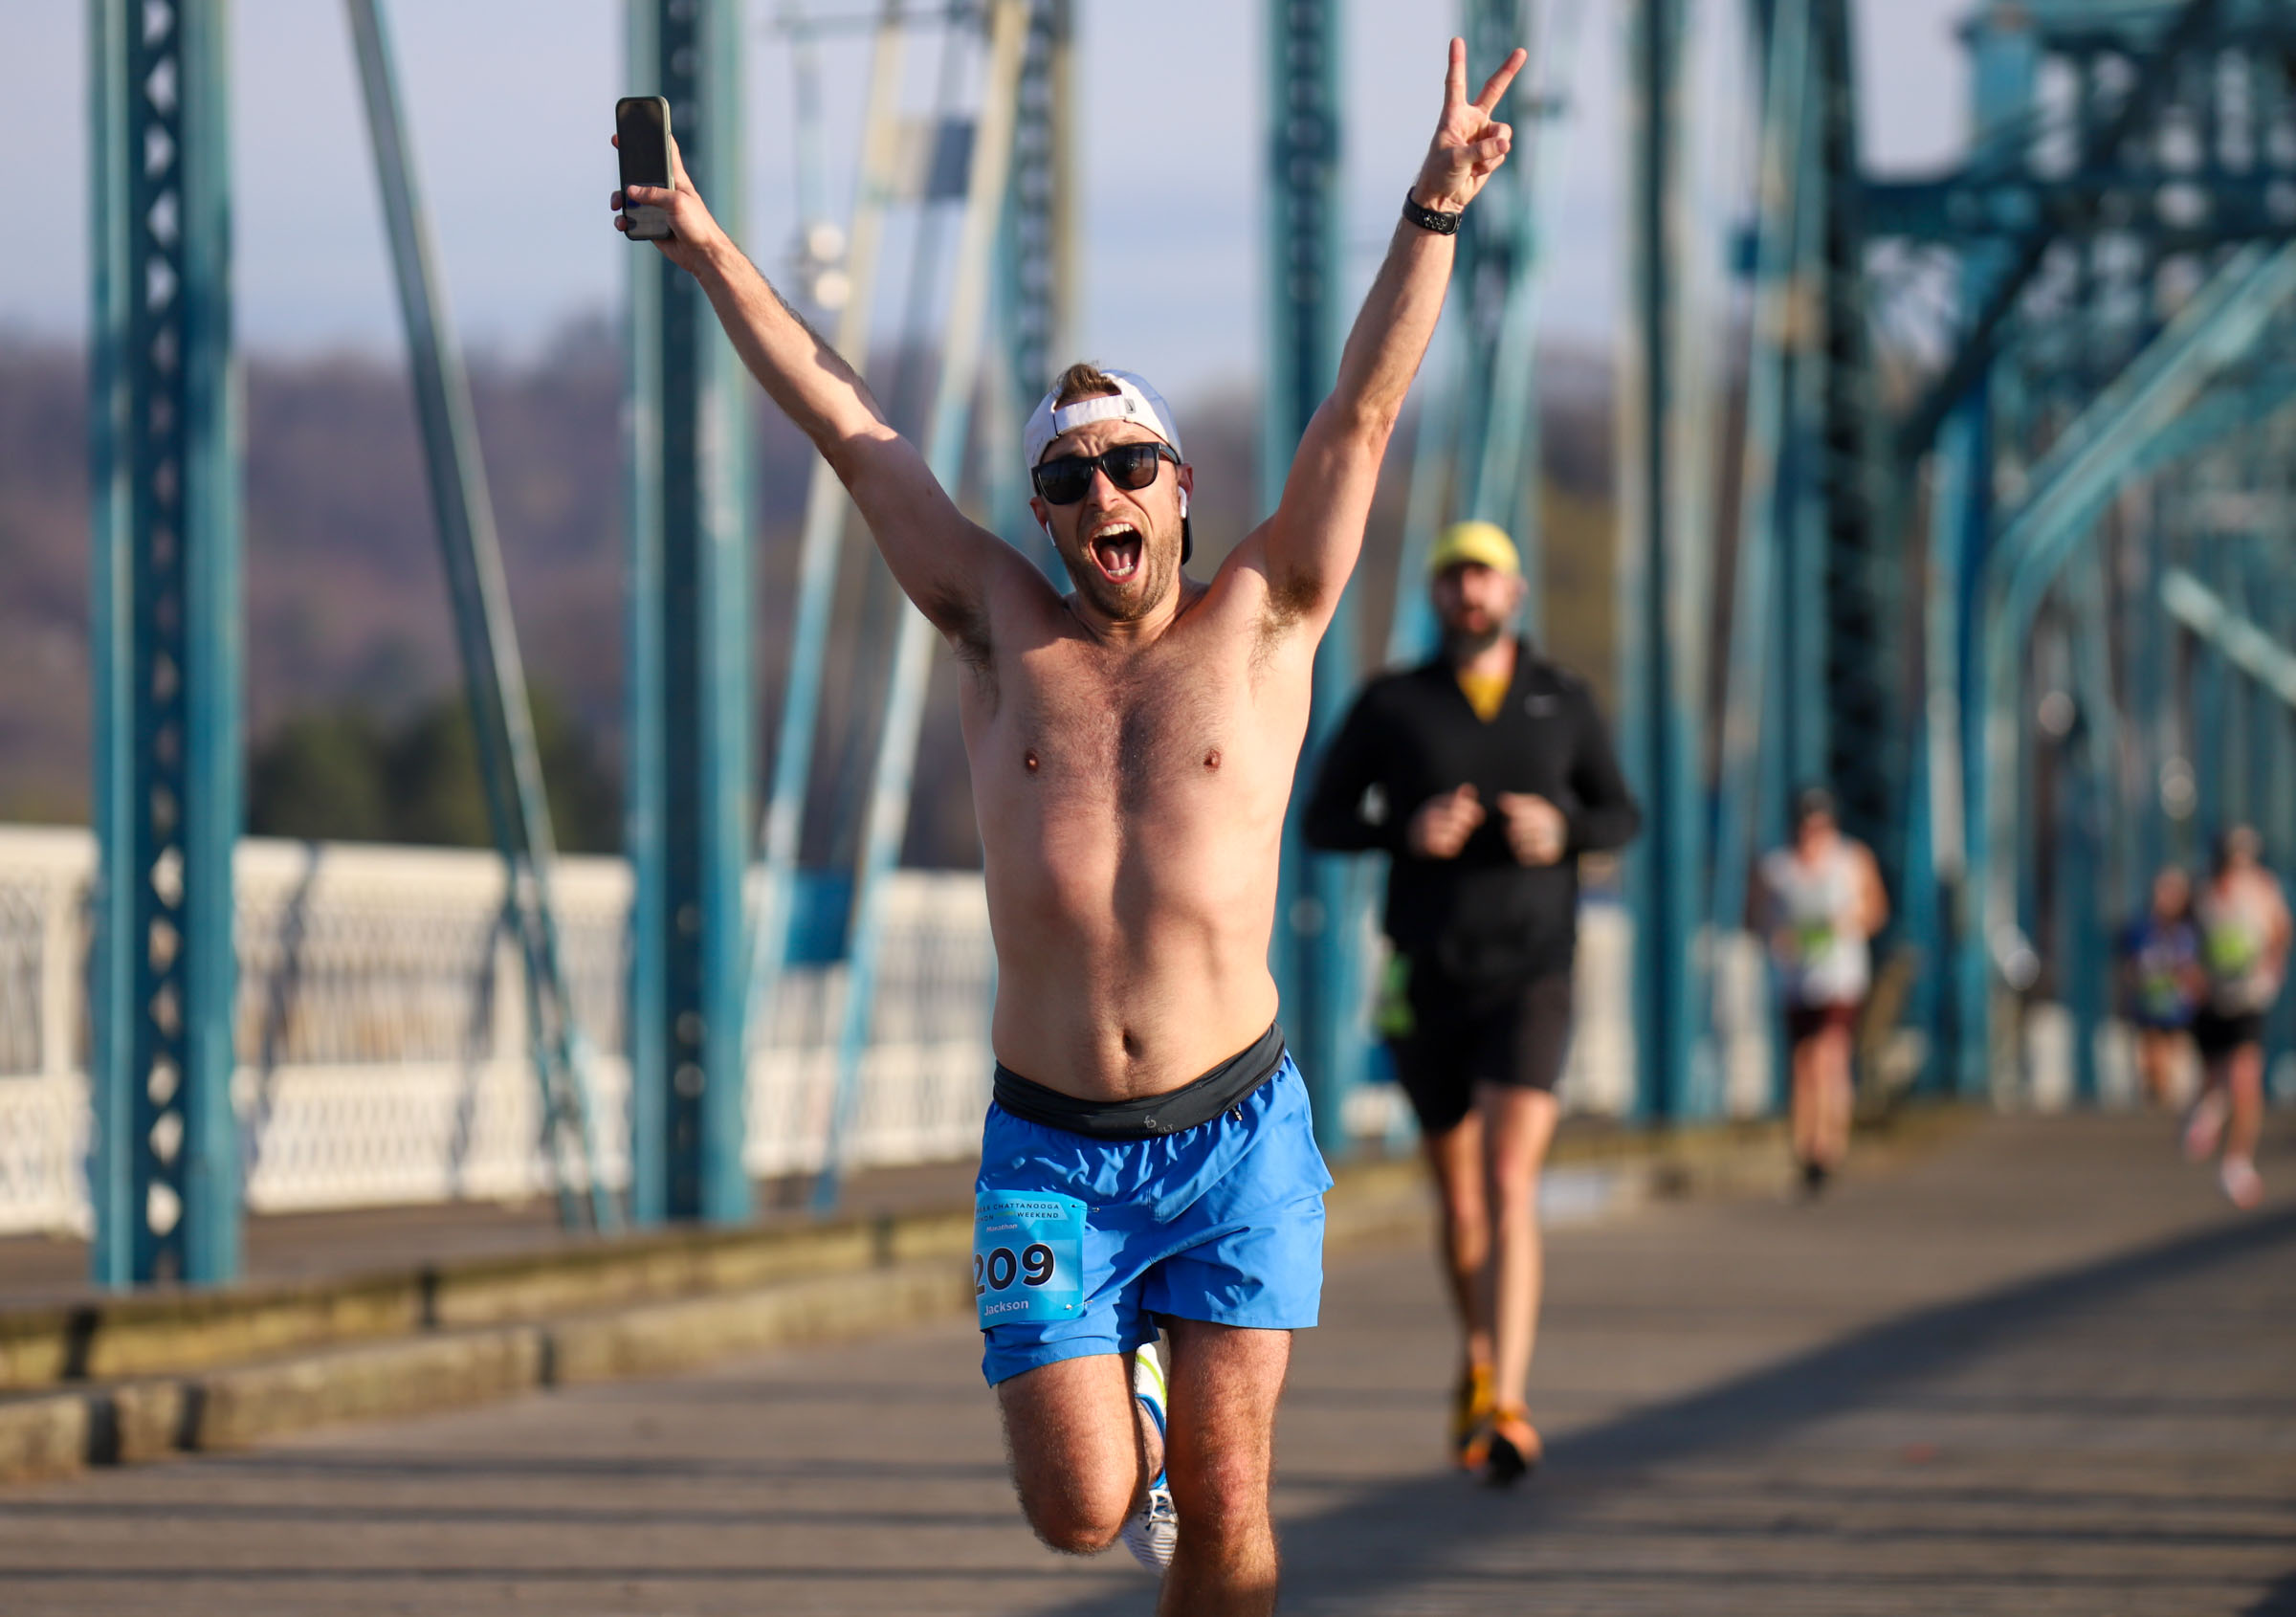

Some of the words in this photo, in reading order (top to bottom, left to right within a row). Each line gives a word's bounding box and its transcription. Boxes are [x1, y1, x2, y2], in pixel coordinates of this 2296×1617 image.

[993, 1202, 1059, 1210] CHATTANOOGA
[985, 1223, 1018, 1232] Marathon
[983, 1300, 1029, 1317] Jackson
